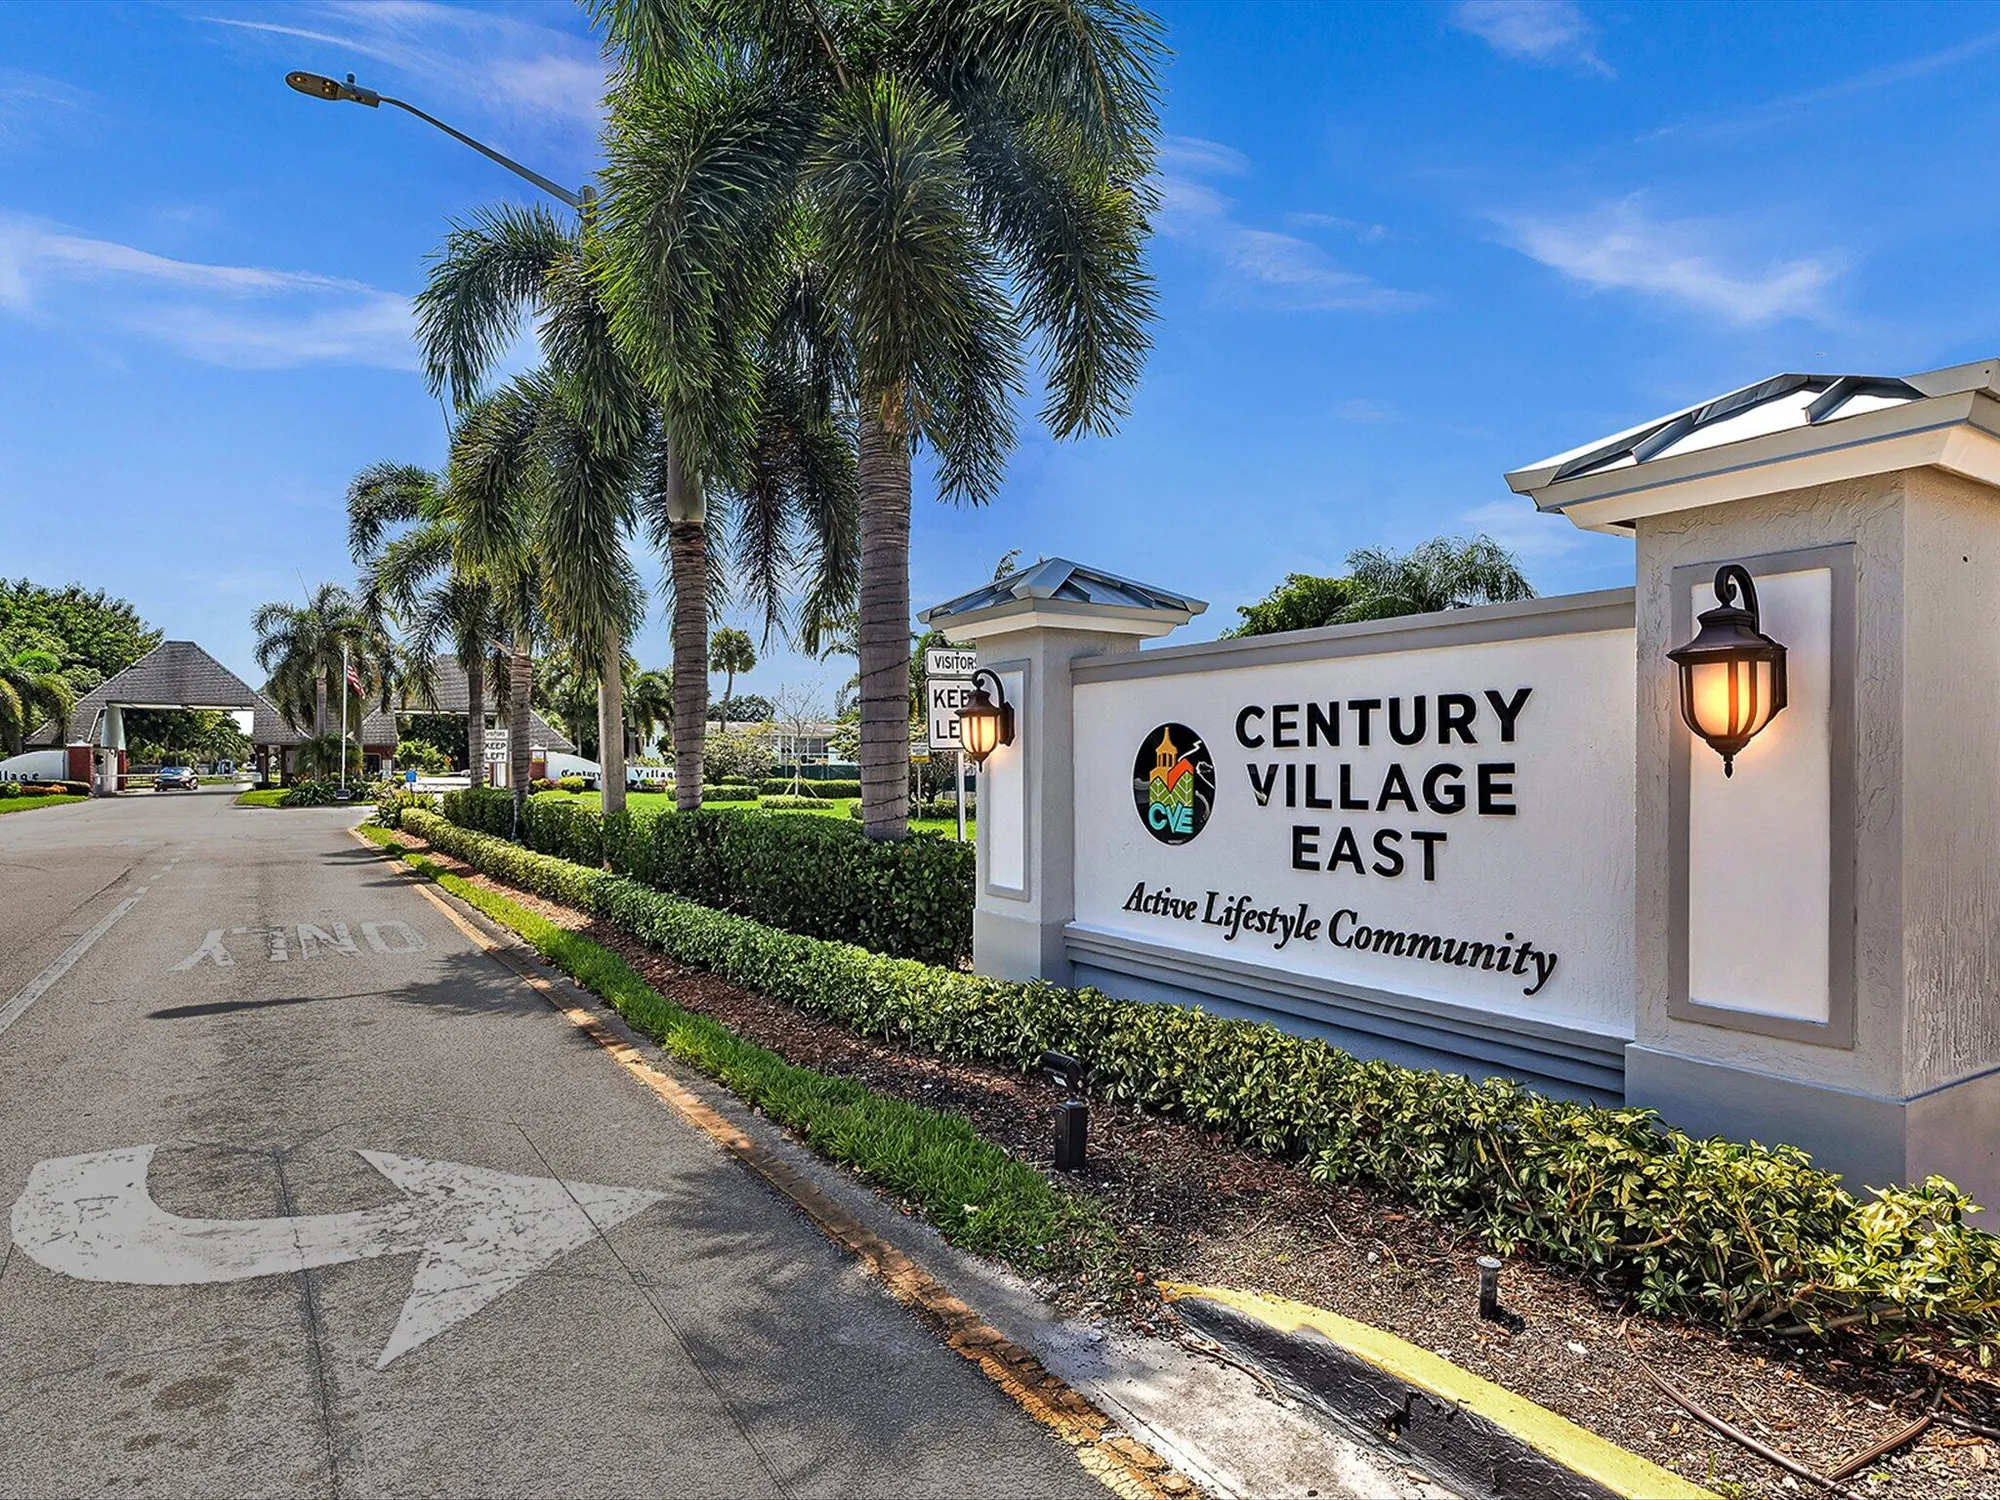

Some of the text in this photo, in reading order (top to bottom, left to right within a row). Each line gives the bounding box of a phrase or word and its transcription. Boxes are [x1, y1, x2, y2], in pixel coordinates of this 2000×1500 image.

[934, 688, 971, 709] KEE
[936, 720, 961, 739] LE
[1235, 687, 1534, 749] CENTURY
[484, 742, 506, 750] KEEP
[485, 752, 505, 760] LEFT
[0, 770, 40, 781] llage
[1246, 762, 1518, 817] VILLAGE
[1148, 801, 1195, 834] CVE
[1291, 825, 1449, 882] EAST
[164, 919, 430, 972] ONLY
[1122, 881, 1559, 996] Active Lifestyle Community
